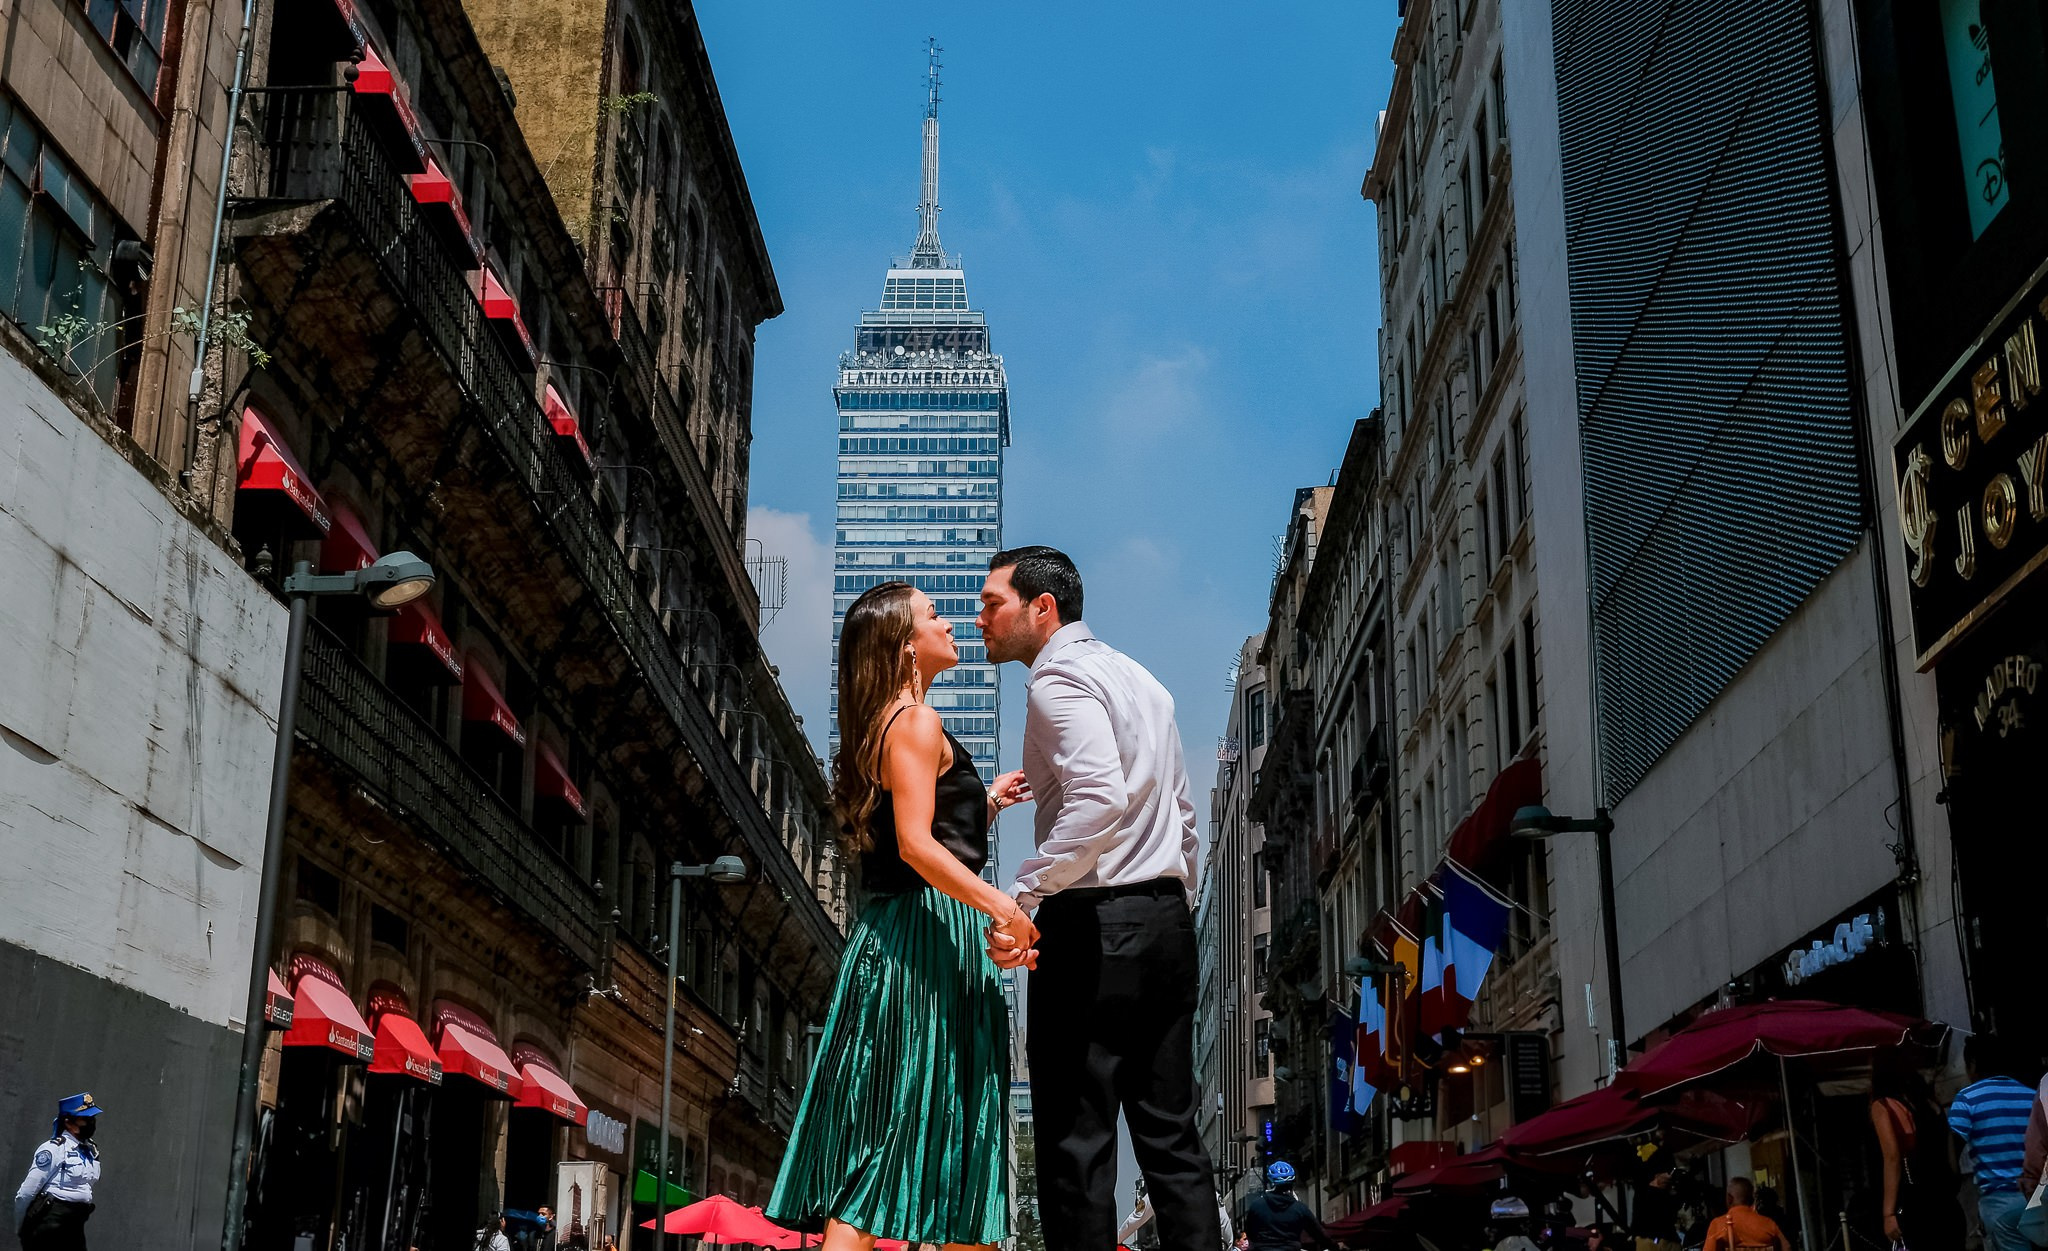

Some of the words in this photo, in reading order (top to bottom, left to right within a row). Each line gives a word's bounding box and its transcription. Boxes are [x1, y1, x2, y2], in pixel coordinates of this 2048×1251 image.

[847, 371, 993, 386] LATINOAMERICANA
[1941, 296, 2048, 472] CEN
[290, 478, 313, 513] Santander
[314, 508, 331, 532] SELECT
[1973, 654, 2042, 733] MADERO
[273, 1006, 293, 1022] SELECT
[334, 1030, 357, 1051] Santander
